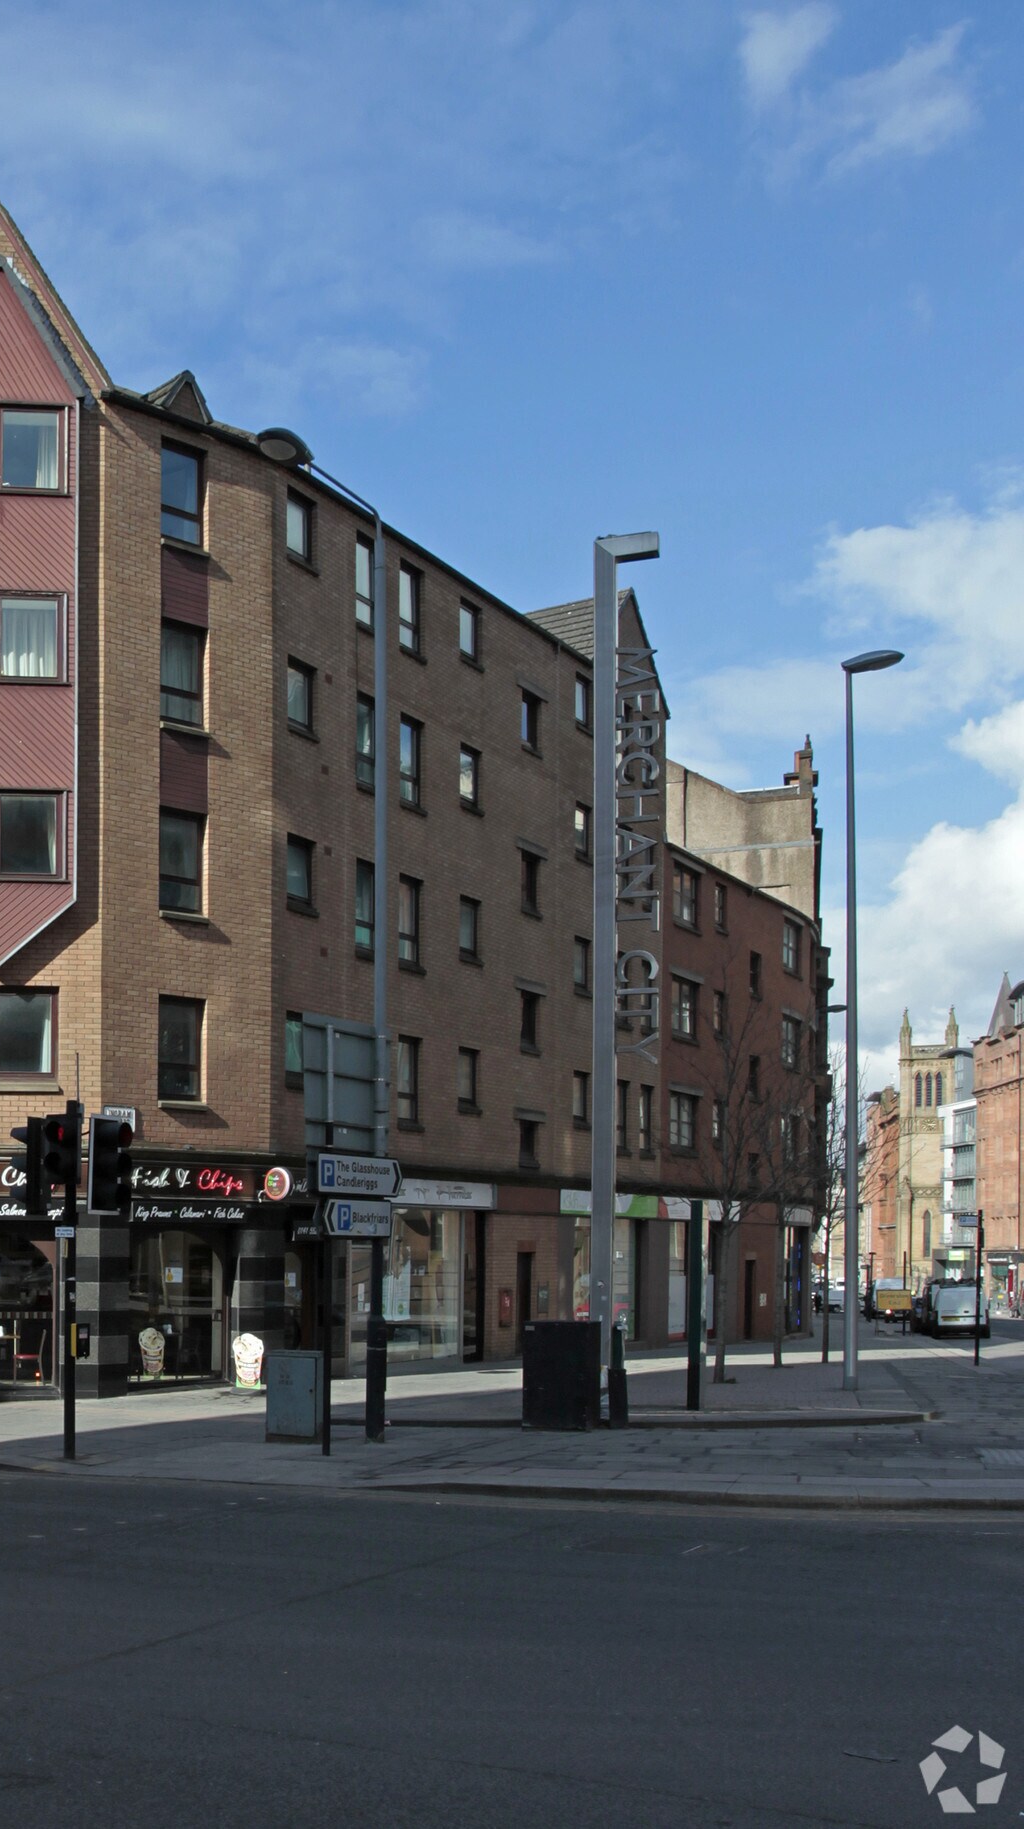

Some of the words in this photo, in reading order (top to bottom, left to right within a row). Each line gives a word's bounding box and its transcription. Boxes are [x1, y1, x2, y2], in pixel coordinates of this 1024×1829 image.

[616, 647, 660, 932] MERCHANT
[616, 950, 660, 1065] CITY
[336, 1161, 350, 1173] The
[351, 1162, 391, 1176] Glasshouse
[130, 1166, 170, 1189] Fish
[175, 1167, 191, 1188] &
[197, 1167, 244, 1195] Chips
[336, 1175, 378, 1191] Candleriggs
[135, 1206, 150, 1221] King
[150, 1206, 172, 1218] Prawns
[179, 1207, 206, 1219] Calamari
[213, 1207, 226, 1219] Fish
[227, 1208, 244, 1219] Cakes
[352, 1211, 389, 1224] Blackfriars
